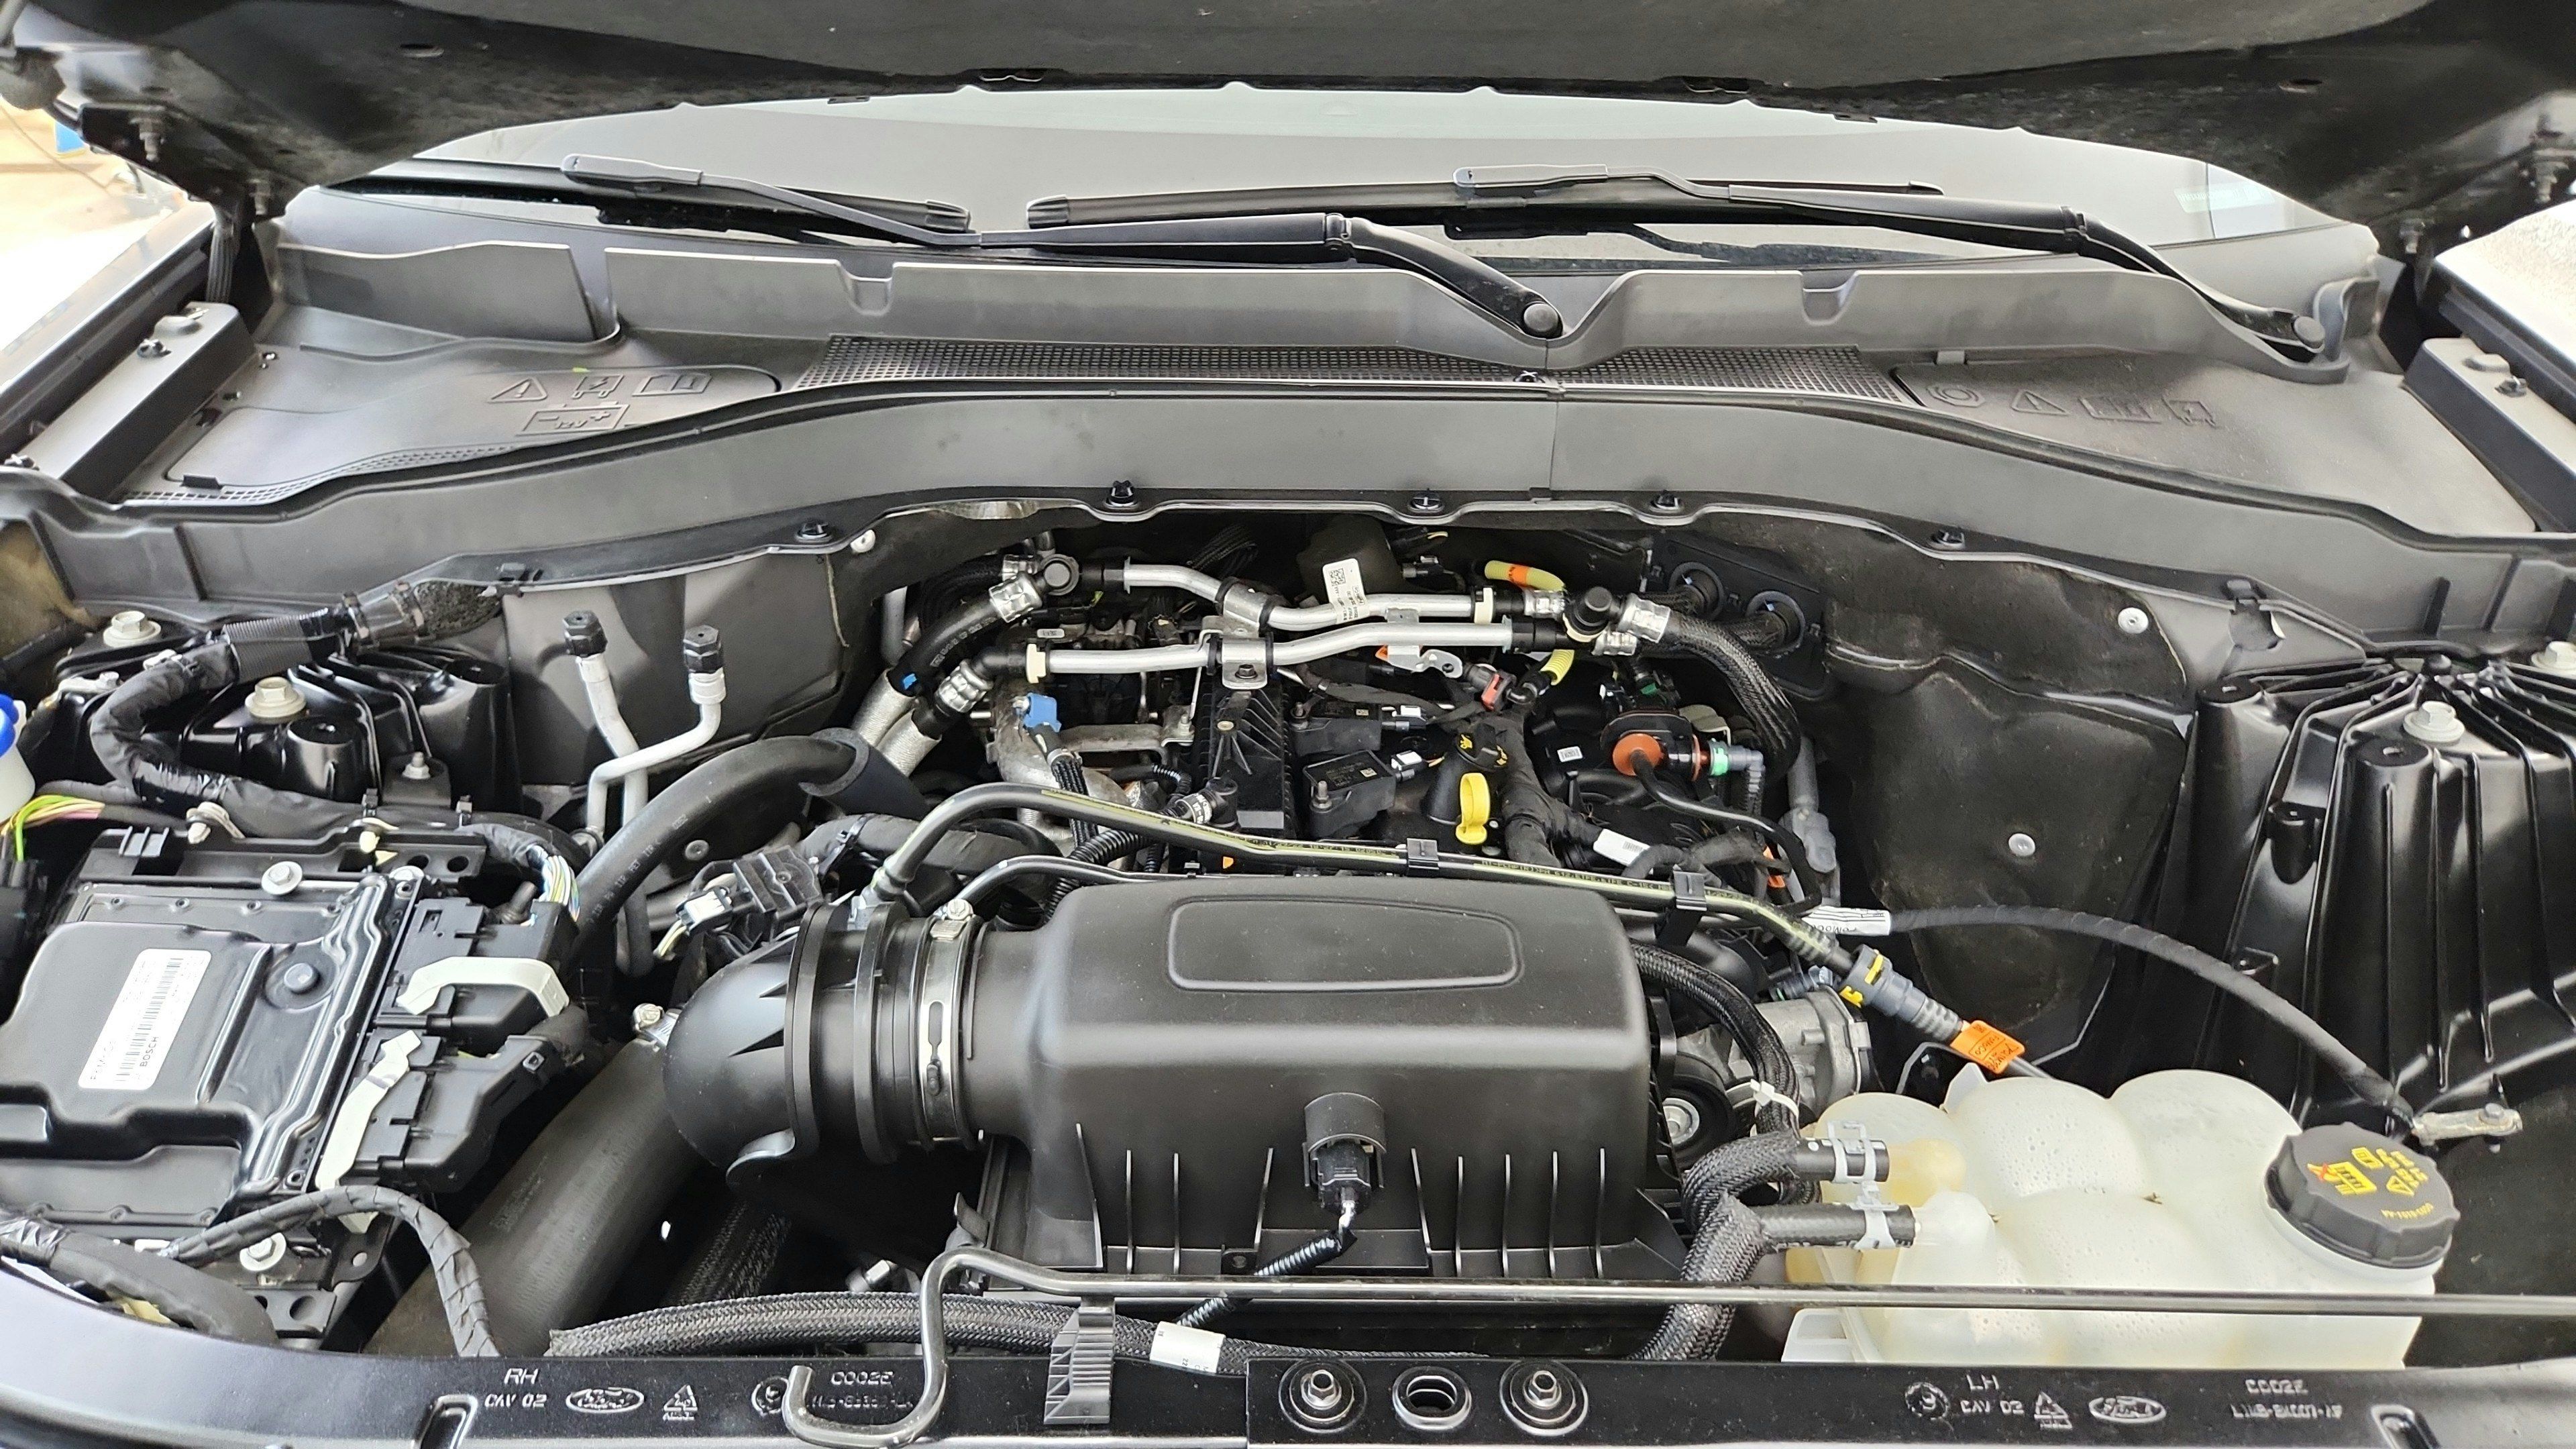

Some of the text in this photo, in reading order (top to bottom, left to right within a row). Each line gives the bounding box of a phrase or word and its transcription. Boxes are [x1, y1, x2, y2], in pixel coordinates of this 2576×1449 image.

[140, 1036, 159, 1067] BOSCH
[504, 1368, 539, 1385] RH
[1966, 1374, 2000, 1391] LH
[484, 1393, 547, 1408] CAV 02
[1960, 1399, 2025, 1414] CAV 02
